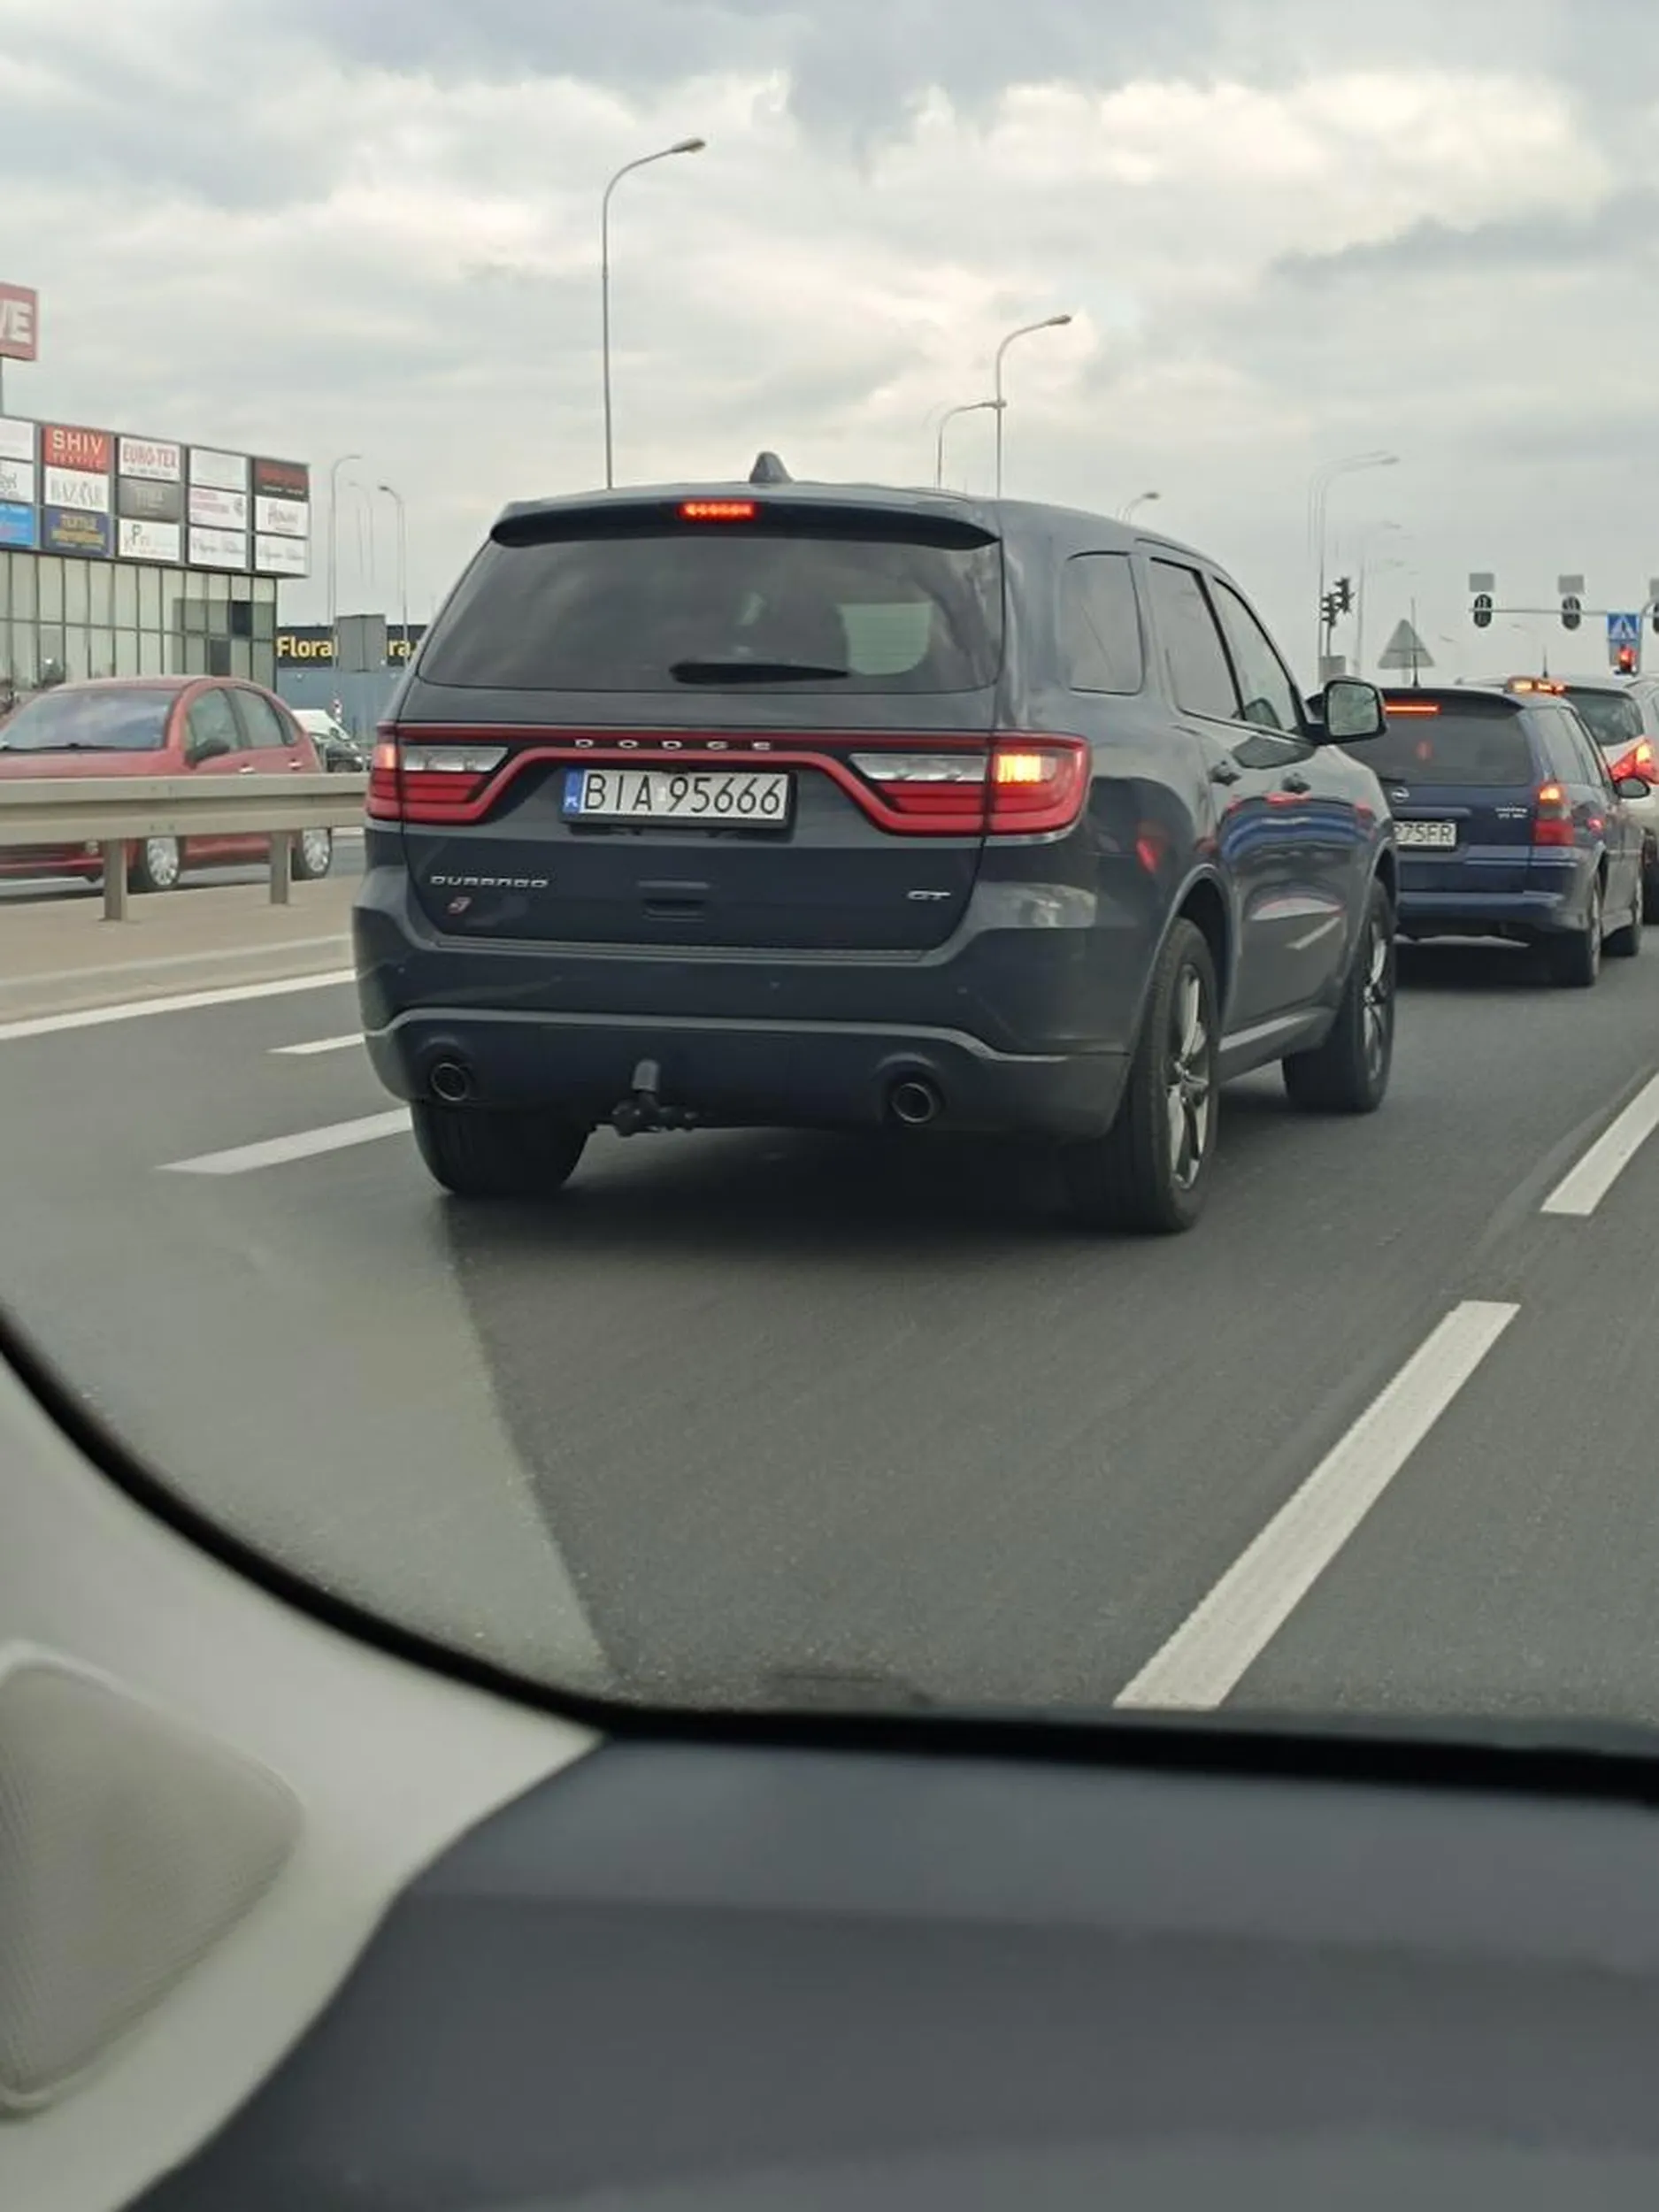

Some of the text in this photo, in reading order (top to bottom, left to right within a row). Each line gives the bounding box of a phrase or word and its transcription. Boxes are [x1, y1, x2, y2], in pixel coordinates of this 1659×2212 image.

[52, 429, 104, 455] SHIV
[575, 738, 772, 751] DODGE
[584, 773, 781, 815] BIA 95666
[430, 875, 549, 888] DURANGO
[907, 890, 951, 901] GT
